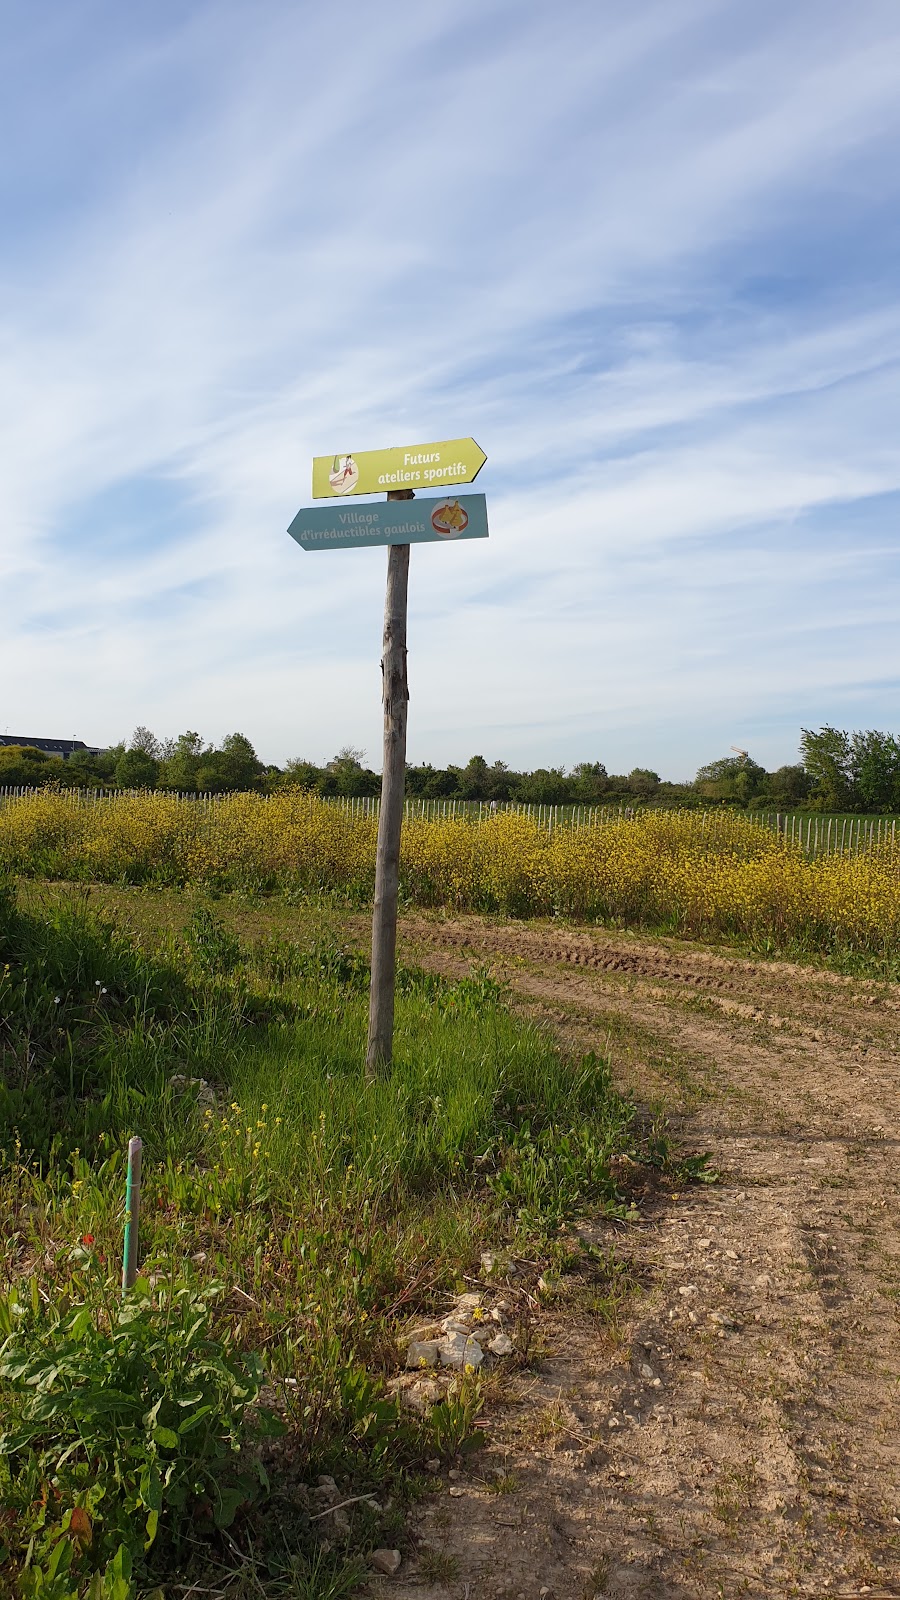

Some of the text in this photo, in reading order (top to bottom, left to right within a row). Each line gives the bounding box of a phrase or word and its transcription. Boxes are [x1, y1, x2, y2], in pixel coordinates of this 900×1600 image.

[404, 452, 440, 466] Futurs
[378, 462, 467, 485] ateliers sportifs
[338, 512, 379, 525] Village
[300, 521, 426, 541] d'irréductibles gaulois
